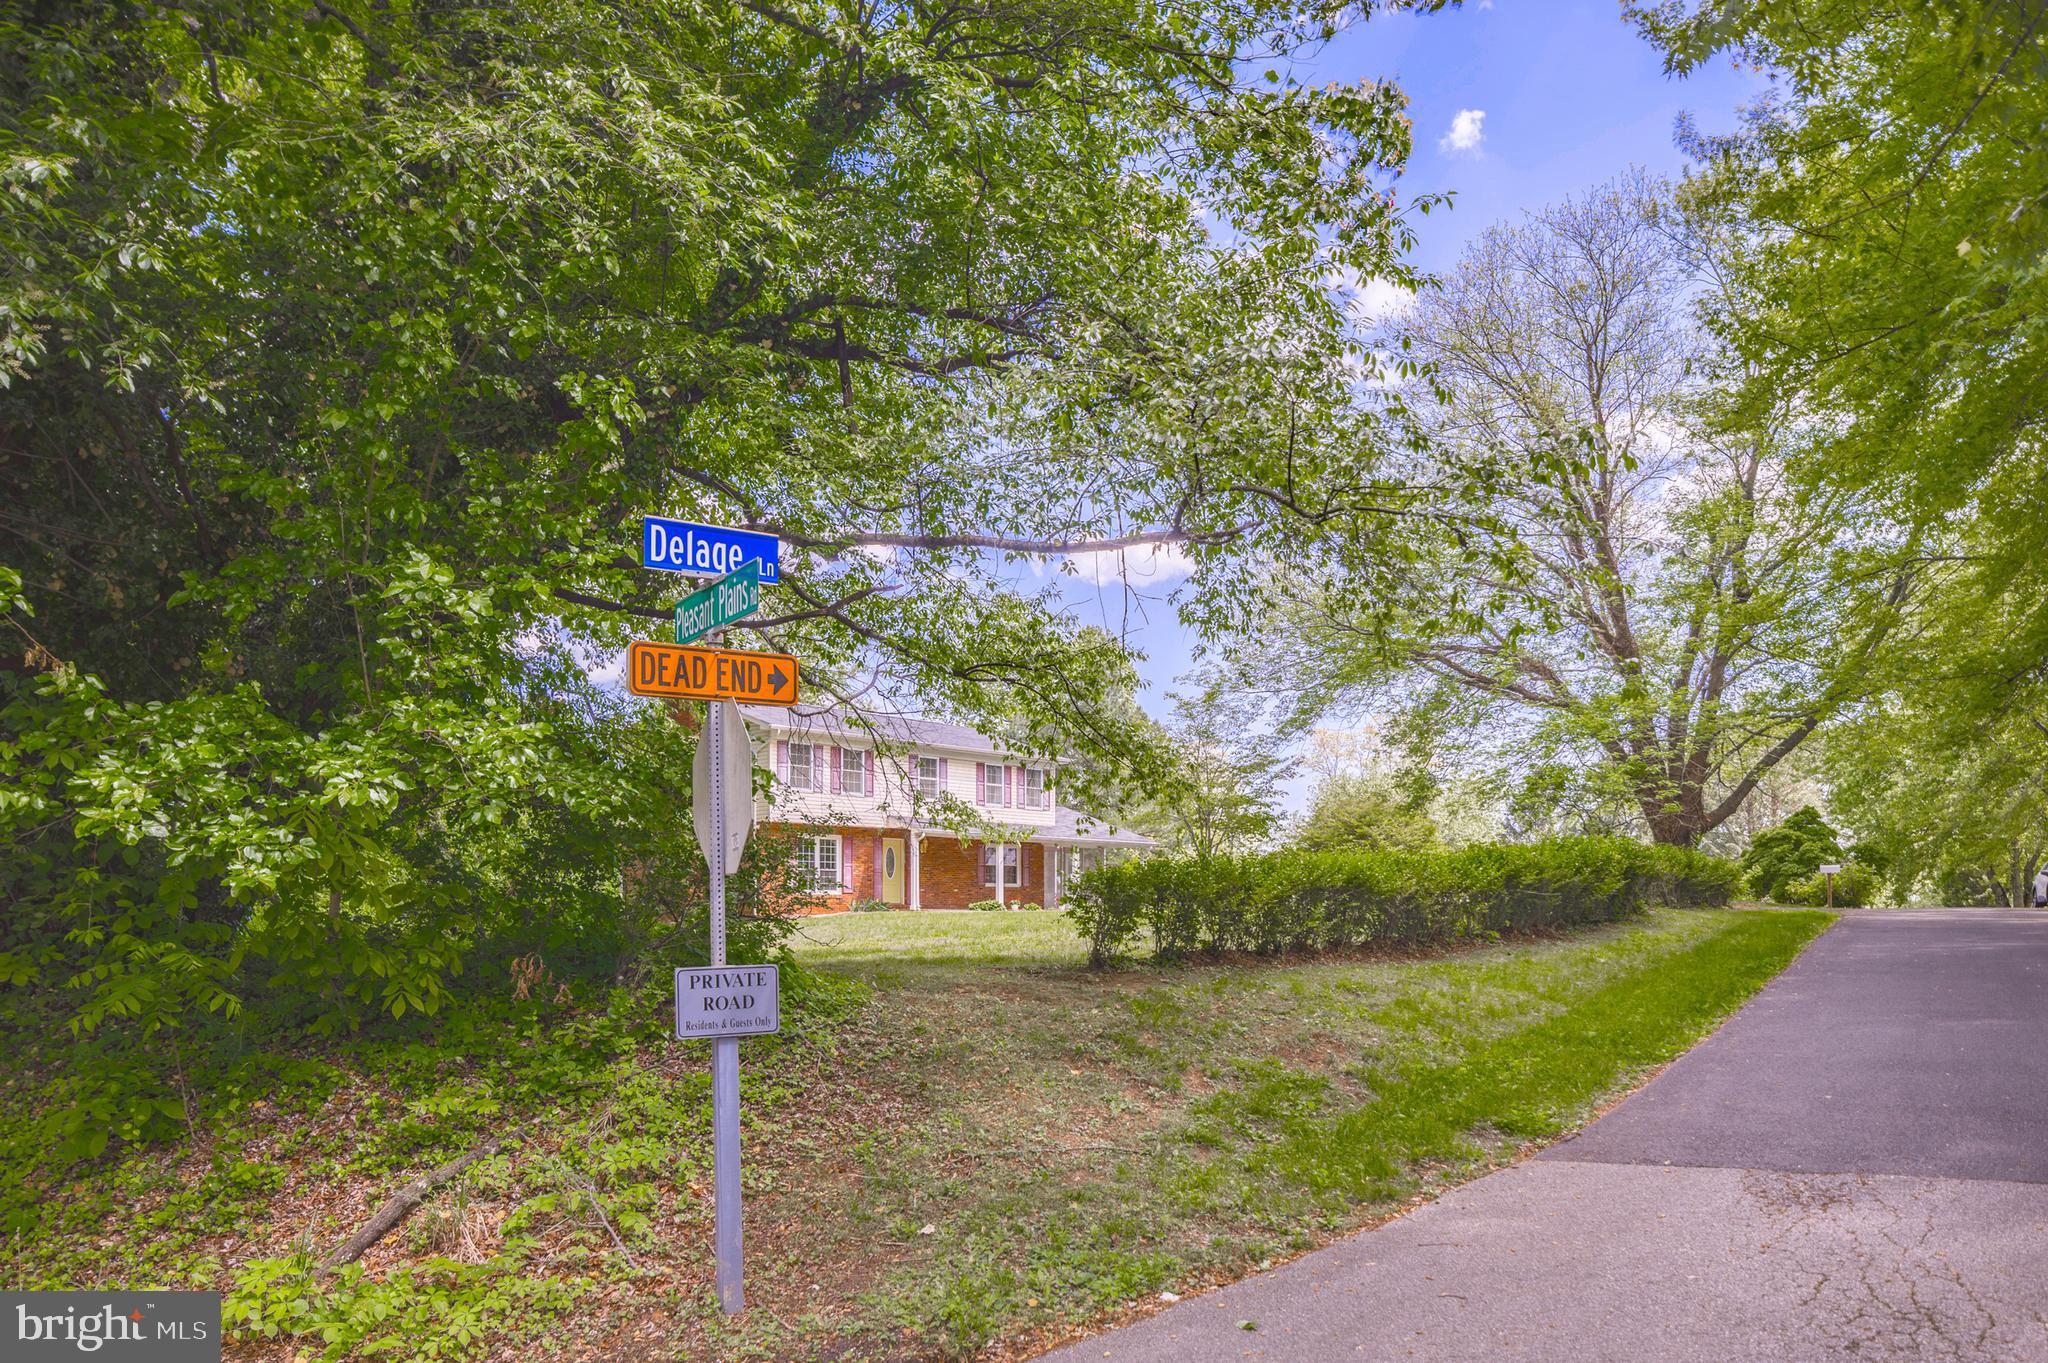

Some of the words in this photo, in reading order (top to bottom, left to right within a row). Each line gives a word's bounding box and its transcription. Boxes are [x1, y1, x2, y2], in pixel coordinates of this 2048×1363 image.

[650, 524, 743, 574] Delage
[759, 557, 774, 577] Ln
[676, 594, 715, 642] Pleasant
[718, 578, 748, 622] Plains
[641, 651, 707, 689] DEAD
[717, 658, 762, 693] END
[690, 972, 767, 989] PRIVATE
[703, 994, 755, 1011] ROAD
[685, 1019, 719, 1032] Residents
[721, 1018, 727, 1029] &
[729, 1017, 753, 1028] Guests
[755, 1015, 771, 1028] Only
